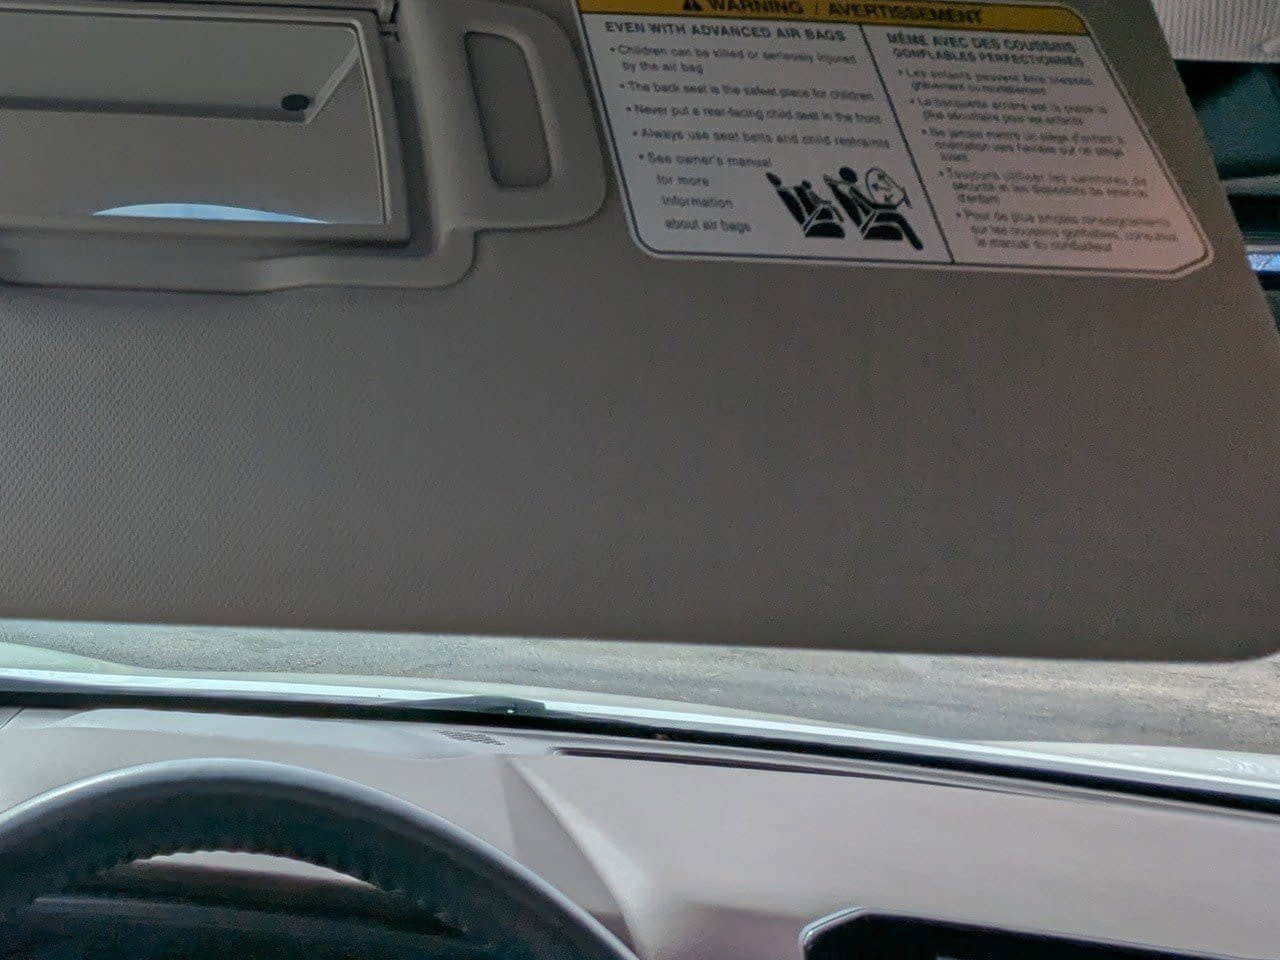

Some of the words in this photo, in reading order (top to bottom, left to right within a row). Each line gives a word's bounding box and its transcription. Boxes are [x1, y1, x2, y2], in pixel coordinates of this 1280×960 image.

[605, 21, 645, 34] EVEN
[650, 22, 687, 36] WITH
[691, 24, 772, 38] ADVANCED
[776, 27, 802, 39] AIR
[805, 28, 847, 41] BAGS
[618, 44, 668, 57] Children
[671, 48, 692, 58] can
[695, 47, 710, 58] be
[713, 47, 744, 59] killed
[747, 50, 759, 59] or
[622, 61, 636, 73] by
[639, 61, 658, 72] the
[662, 62, 677, 72] air
[628, 80, 651, 92] The
[653, 82, 680, 93] back
[683, 83, 707, 94] seat
[721, 84, 741, 96] the
[634, 103, 668, 115] Never
[671, 105, 690, 118] put
[641, 127, 684, 142] Always
[646, 151, 672, 164] See
[675, 154, 724, 166] owner's
[726, 157, 773, 168] manual
[656, 174, 673, 185] for
[677, 175, 710, 187] more
[662, 195, 734, 209] information
[665, 219, 699, 231] about
[702, 220, 718, 231] air
